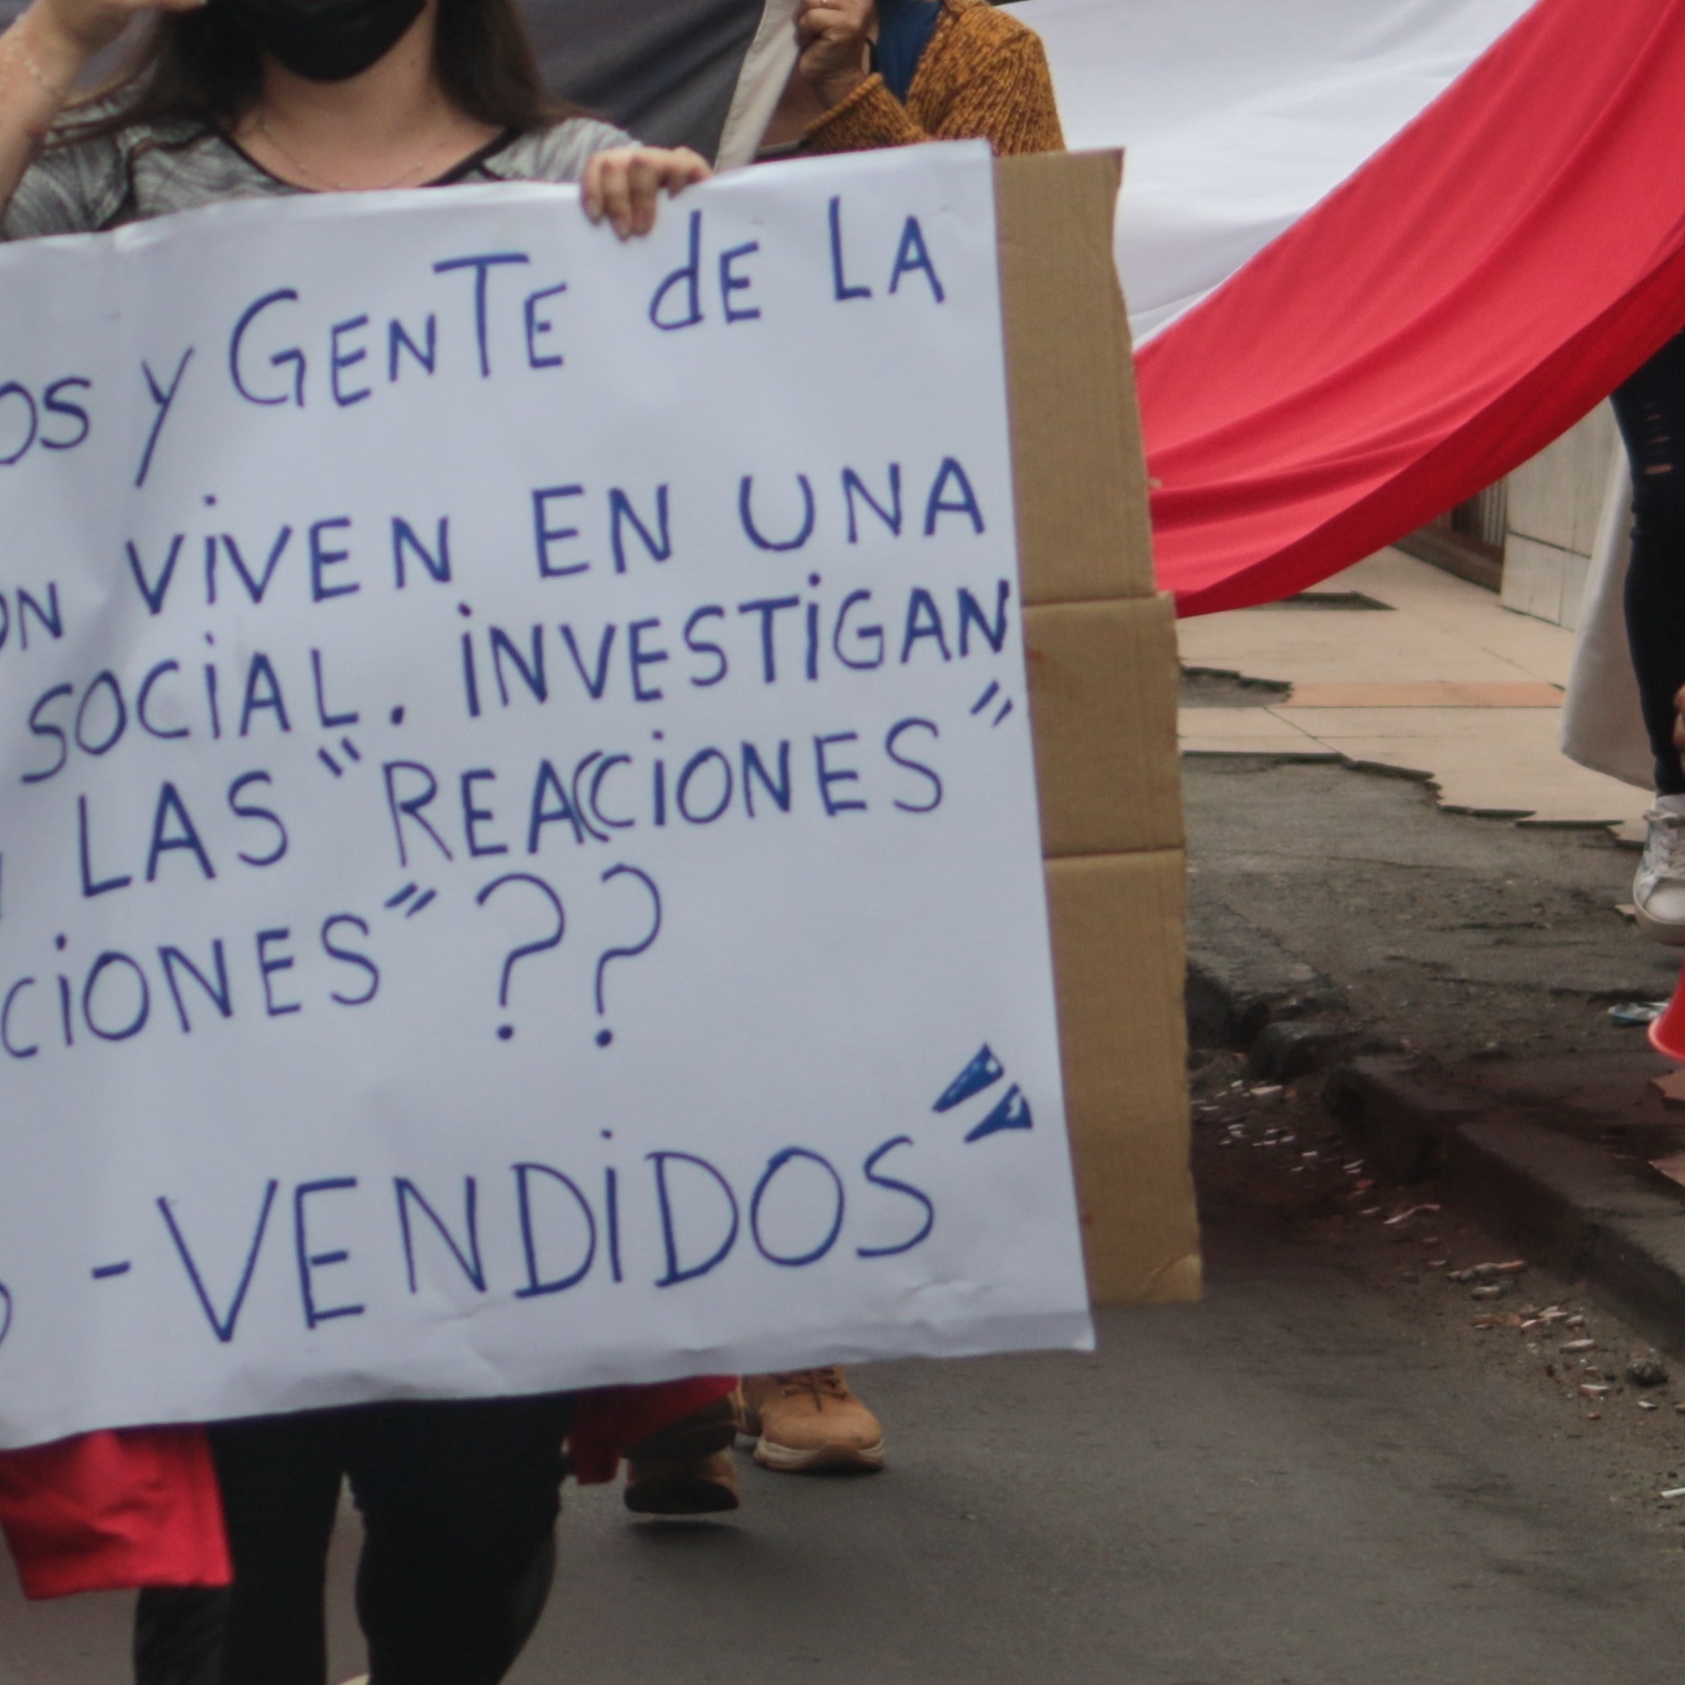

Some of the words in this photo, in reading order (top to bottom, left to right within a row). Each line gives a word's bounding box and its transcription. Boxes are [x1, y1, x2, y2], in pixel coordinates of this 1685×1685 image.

[829, 195, 946, 306] LA
[531, 483, 674, 580] EN
[738, 454, 987, 553] UNA
[76, 769, 289, 899] LAS
